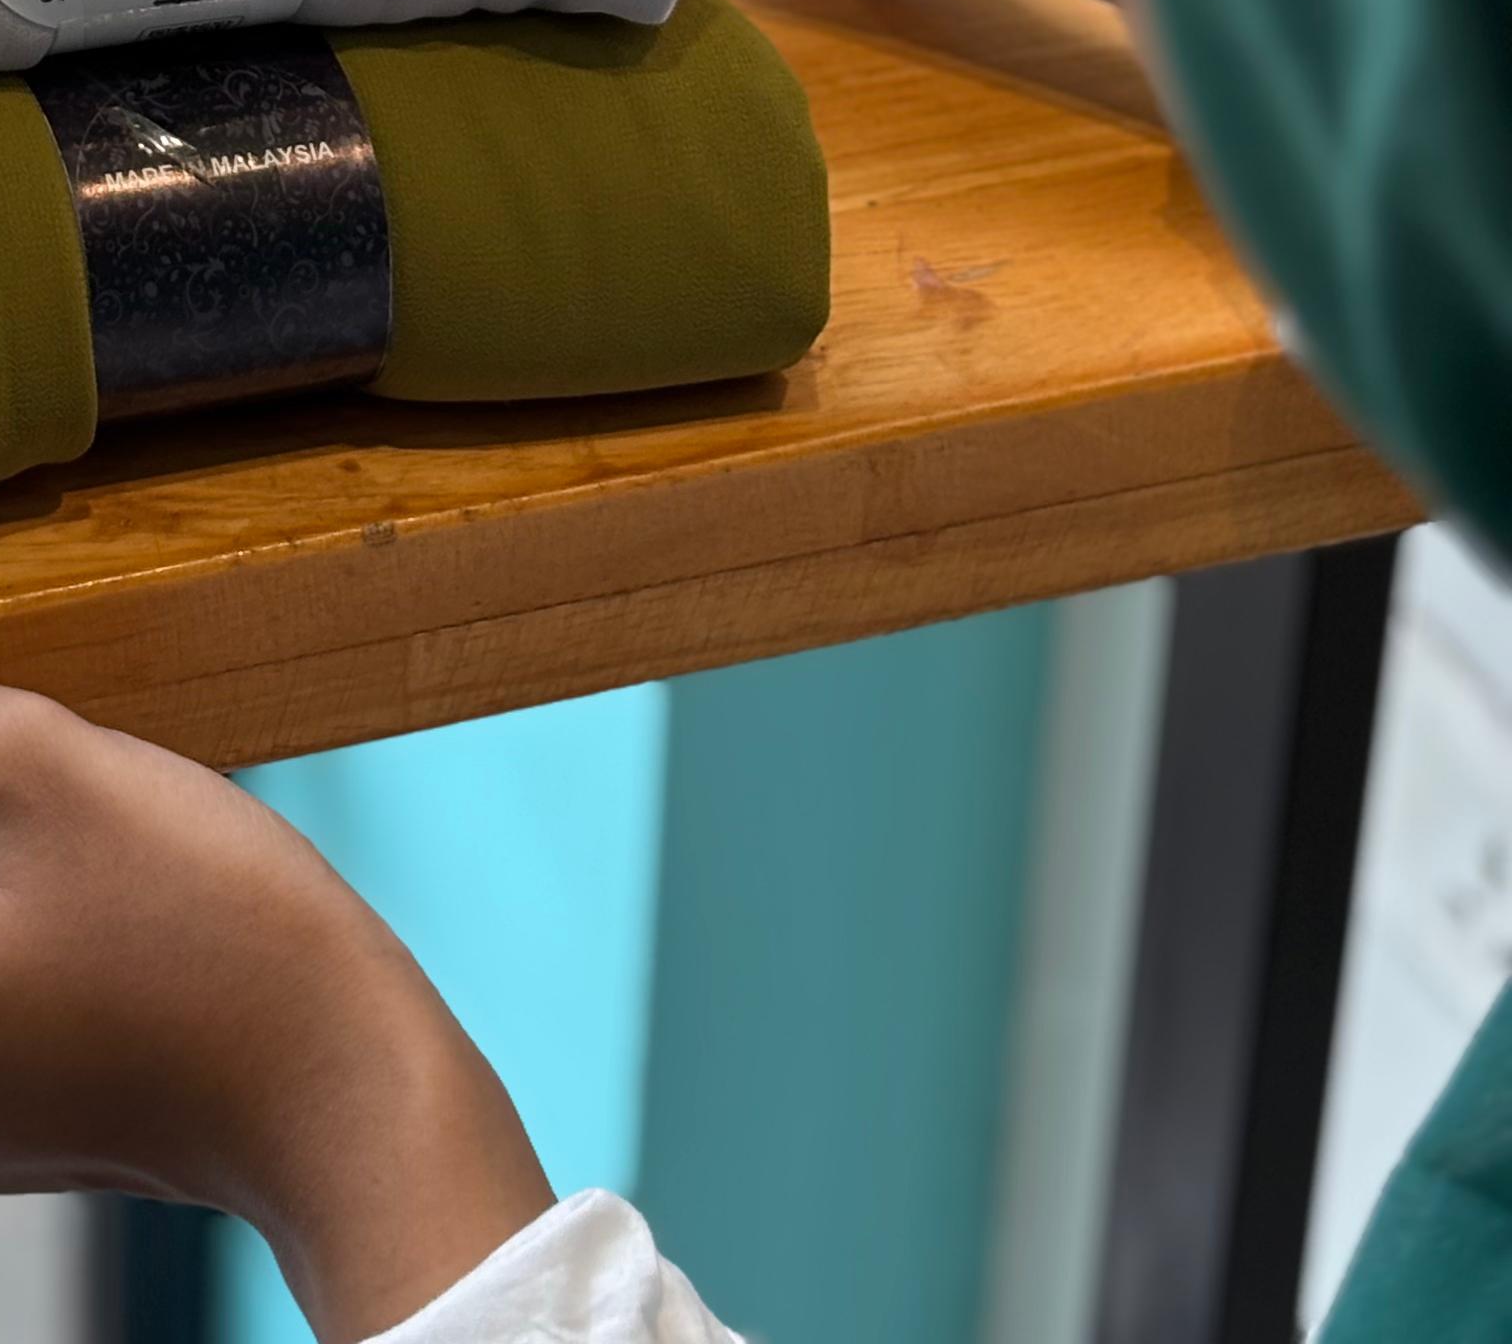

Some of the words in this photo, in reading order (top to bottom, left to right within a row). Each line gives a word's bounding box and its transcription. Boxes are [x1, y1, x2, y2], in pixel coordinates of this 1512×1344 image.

[104, 164, 175, 191] MADE
[181, 160, 206, 180] IN
[210, 141, 335, 177] MALAYSIA
